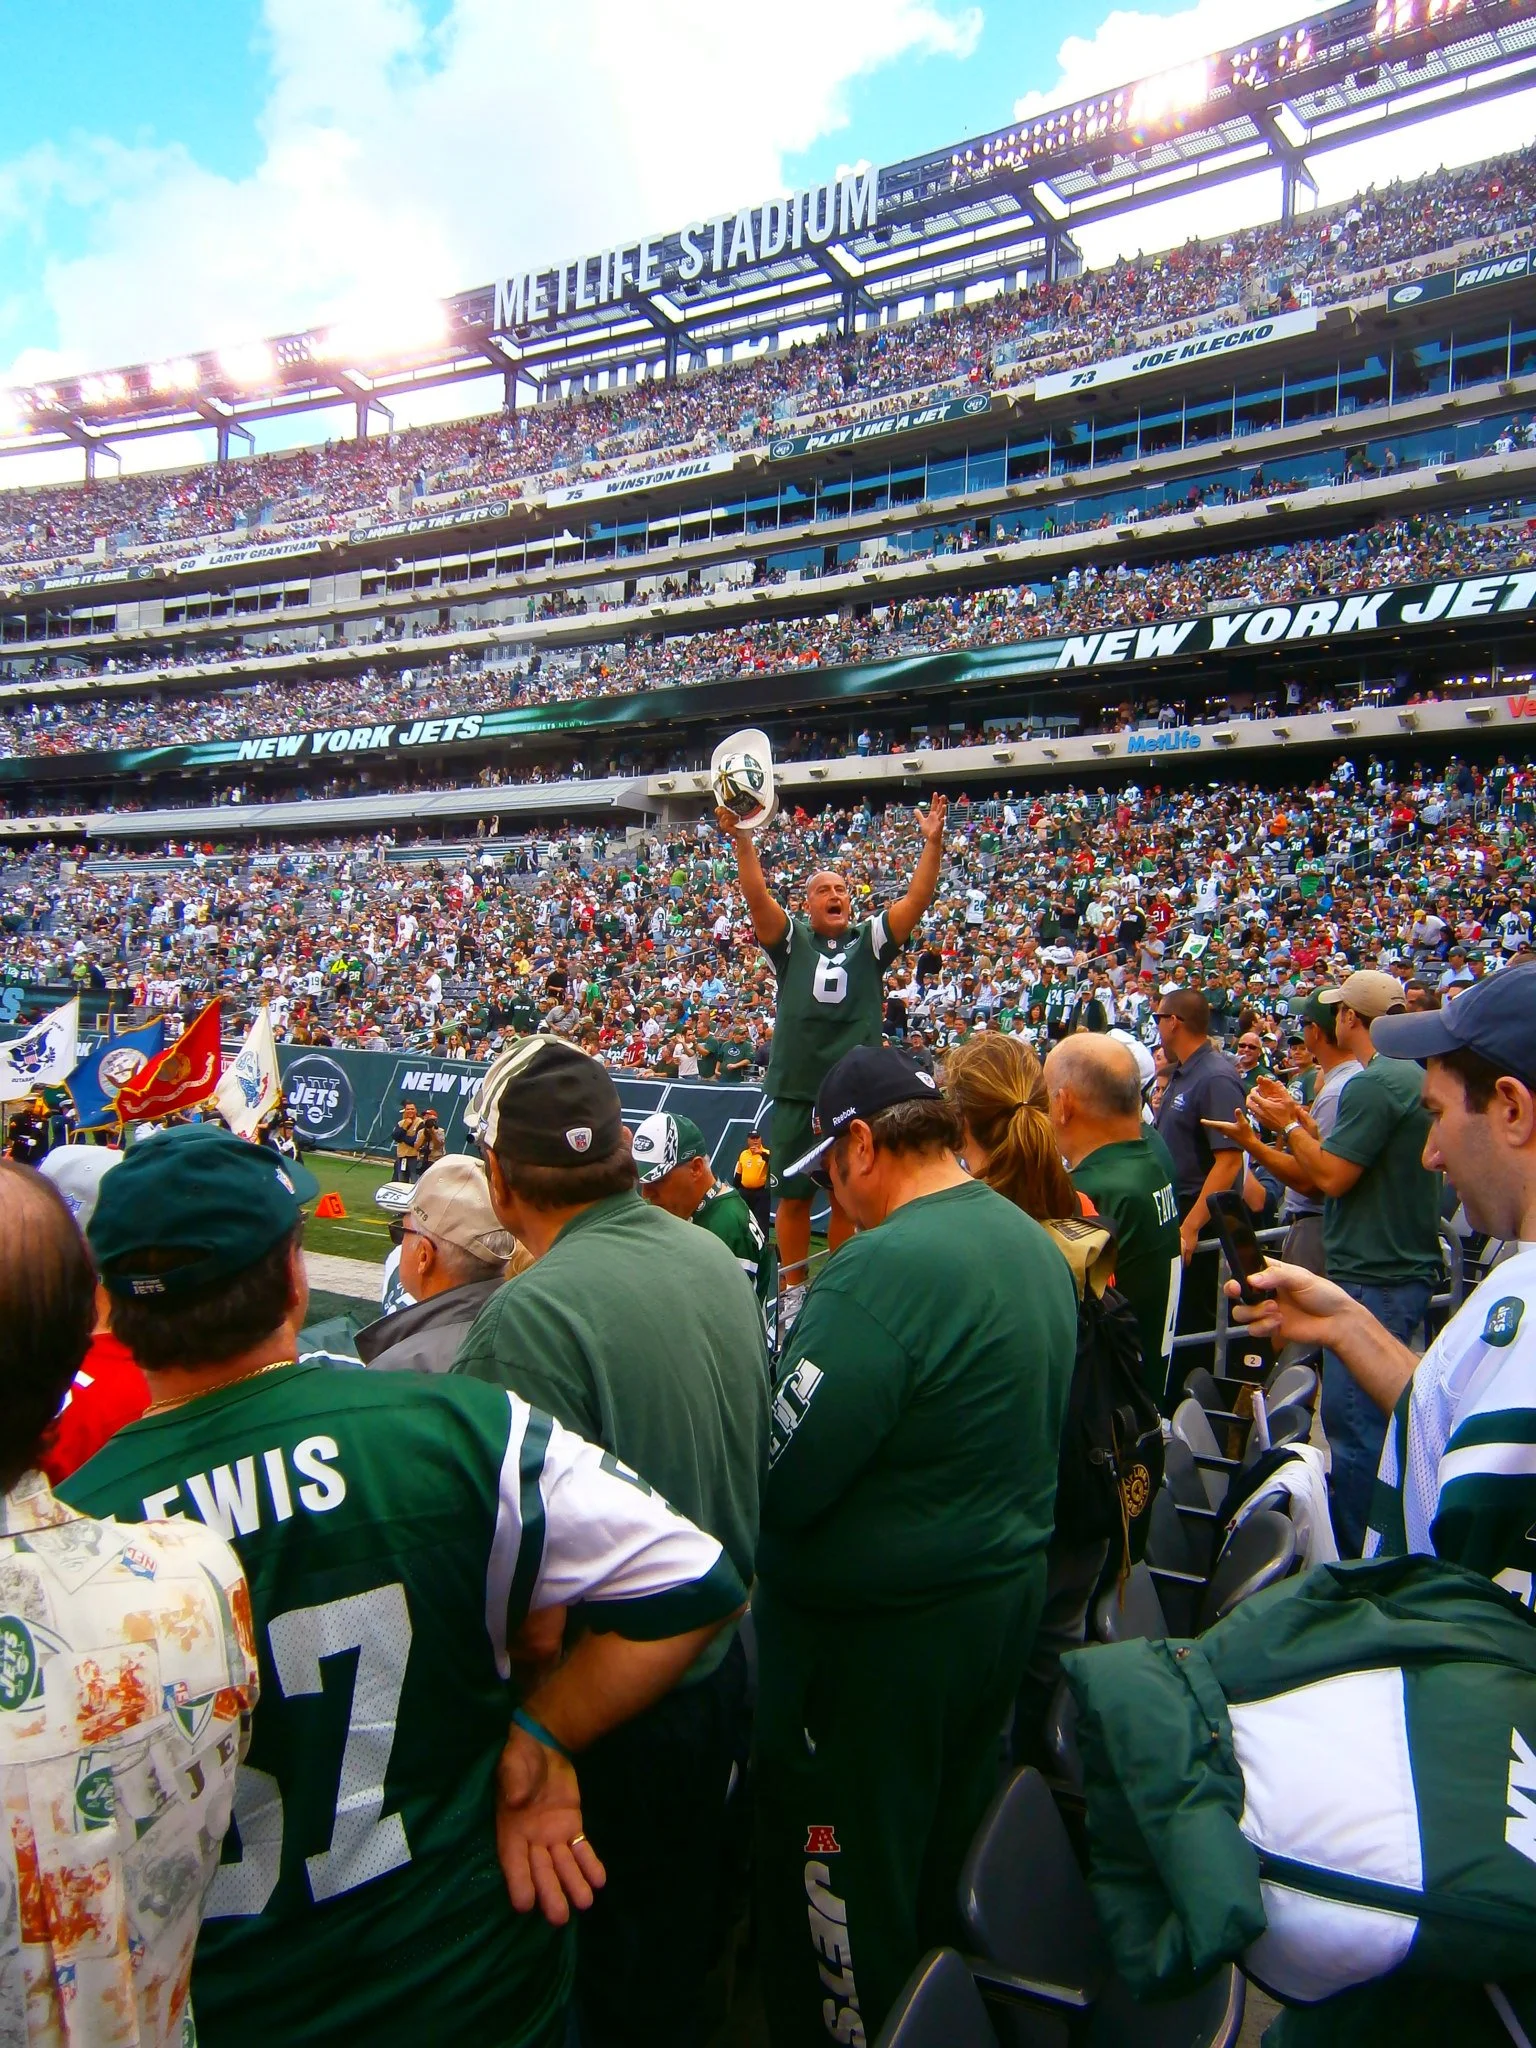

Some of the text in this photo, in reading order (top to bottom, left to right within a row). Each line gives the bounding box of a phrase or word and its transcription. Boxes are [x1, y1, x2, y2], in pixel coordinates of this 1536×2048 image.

[494, 165, 880, 330] METLIFE STADIUM
[1456, 256, 1527, 288] RING
[1070, 324, 1274, 388] 73 JOE KLECKO
[805, 405, 951, 450] PLAY LIKE A JET
[566, 462, 711, 500] 75 WINSTON HILL
[367, 507, 490, 539] HOME OF THE JETS
[180, 540, 318, 570] 60 LARRY GRANTHAM
[81, 574, 94, 585] IT
[1054, 571, 1536, 669] NEW YORK JET
[1508, 696, 1536, 718] Ve
[237, 714, 483, 761] NEW YORK JETS
[1128, 731, 1201, 753] MetLife
[1153, 910, 1164, 921] 21
[813, 953, 848, 1003] 6
[289, 1083, 339, 1108] JETS
[401, 1071, 484, 1096] NEW YO
[833, 1107, 856, 1127] Reebok
[330, 1197, 341, 1214] G
[377, 1191, 402, 1201] JETS
[414, 1206, 428, 1221] JETS
[133, 1284, 165, 1294] JETS
[1493, 1305, 1506, 1333] JETS
[104, 1435, 346, 1541] EWIS
[803, 1860, 867, 2048] JETS
